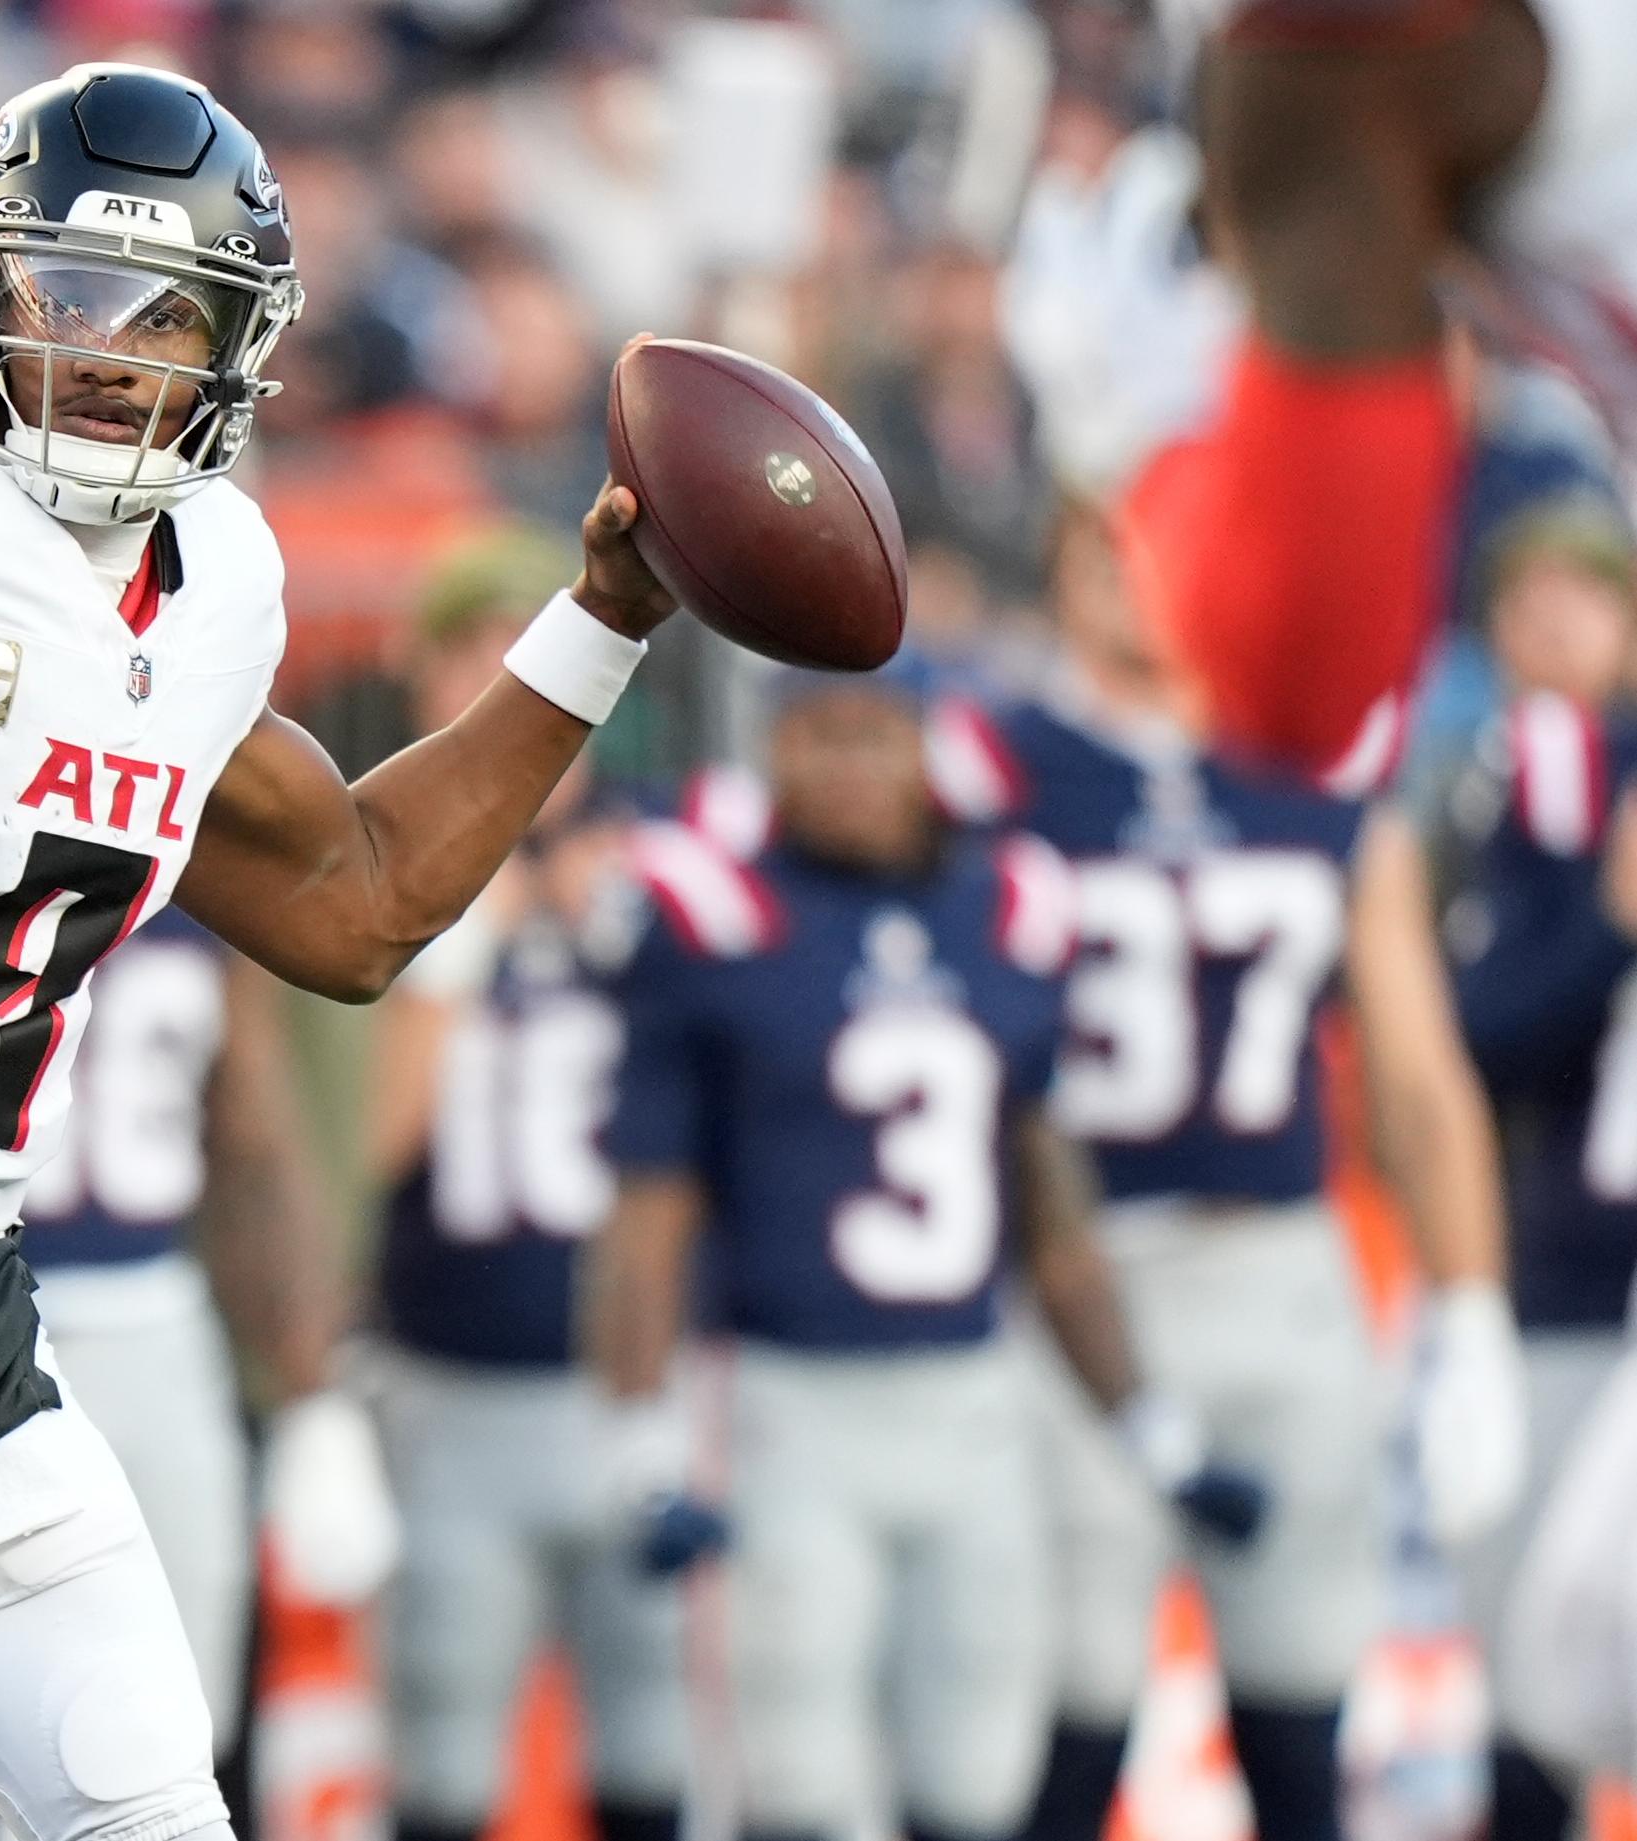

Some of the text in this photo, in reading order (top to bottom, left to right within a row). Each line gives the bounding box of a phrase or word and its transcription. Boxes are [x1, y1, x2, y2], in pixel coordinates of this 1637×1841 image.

[102, 198, 163, 223] ATL
[16, 737, 186, 841] ATL
[1047, 847, 1346, 1142] 37
[828, 1005, 1003, 1303] 3
